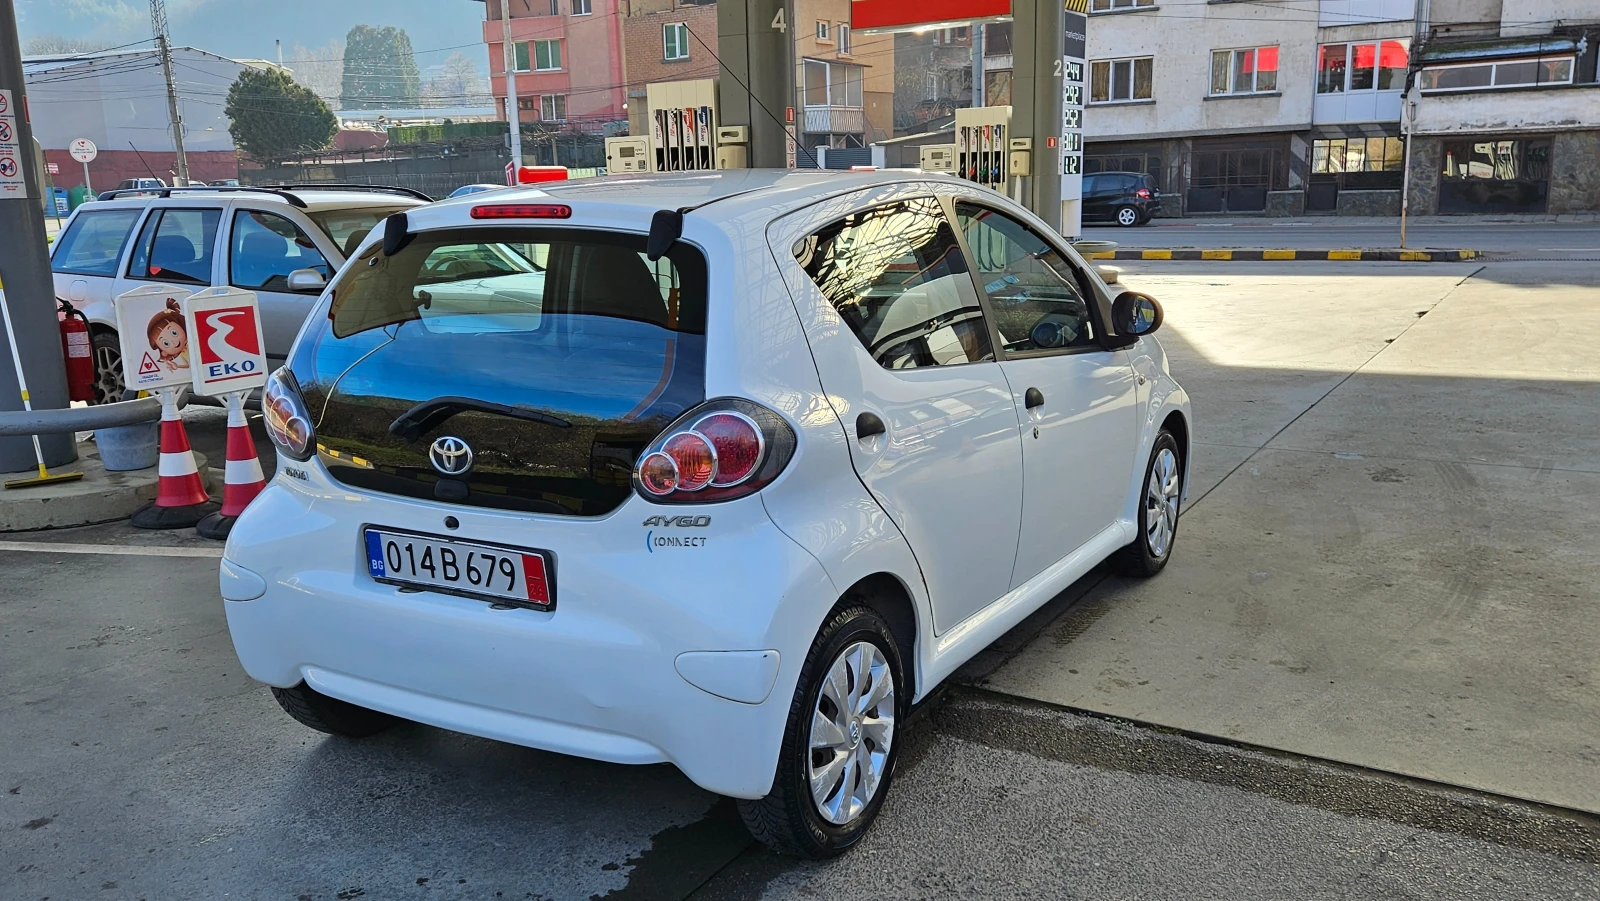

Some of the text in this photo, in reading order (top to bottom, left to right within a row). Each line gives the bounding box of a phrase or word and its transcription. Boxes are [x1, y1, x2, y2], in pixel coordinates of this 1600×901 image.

[772, 8, 787, 33] 4
[1054, 59, 1062, 77] 2
[209, 360, 255, 377] EKO
[642, 515, 711, 527] AYGO
[372, 559, 384, 570] BG
